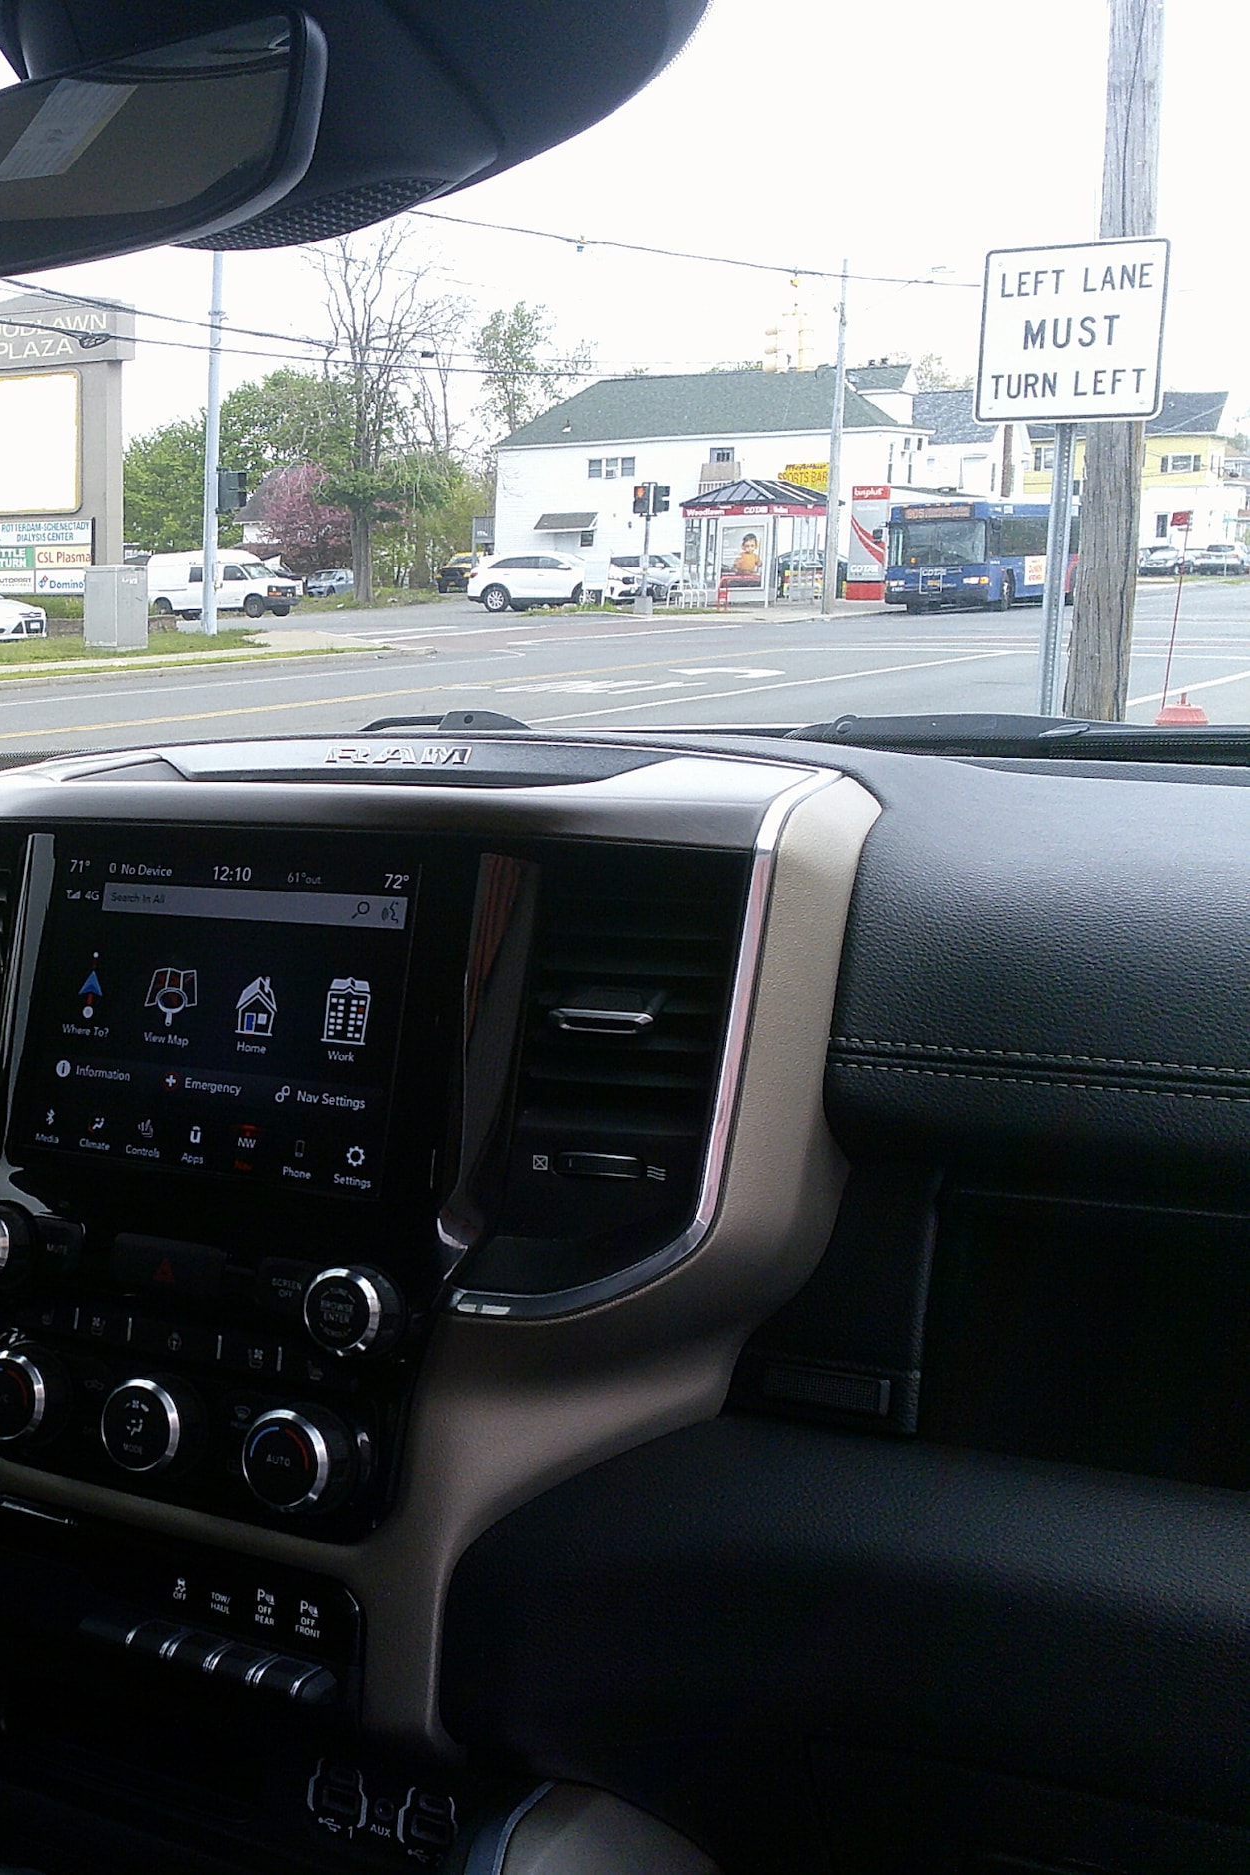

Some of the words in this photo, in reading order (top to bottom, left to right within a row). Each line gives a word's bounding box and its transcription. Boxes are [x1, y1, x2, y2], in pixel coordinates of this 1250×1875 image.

[1001, 269, 1065, 298] LEFT
[1083, 263, 1154, 293] LANE
[1023, 314, 1120, 350] MUST
[991, 372, 1057, 400] TURN
[1073, 368, 1146, 396] LEFT
[1, 522, 90, 533] ROTTERDAM-SCHENECTADY
[17, 533, 46, 542] DIALYSIS
[47, 532, 74, 541] CENTER
[37, 552, 54, 563] CSL
[56, 551, 91, 563] Plasma
[324, 745, 473, 765] RAM
[69, 859, 91, 873] 71°
[121, 863, 136, 875] No
[138, 863, 173, 877] Device
[212, 866, 252, 882] 12:10
[384, 873, 410, 889] 72°
[84, 890, 100, 900] 4G
[110, 892, 140, 903] Search
[62, 1023, 91, 1036] Where
[93, 1026, 110, 1038] To?
[144, 1031, 165, 1044] View
[167, 1034, 189, 1048] Map
[236, 1041, 267, 1055] Home
[328, 1050, 355, 1063] Work
[76, 1065, 131, 1082] Information
[184, 1077, 242, 1097] Emergency
[297, 1090, 319, 1103] Nav
[321, 1093, 366, 1111] Settings
[35, 1133, 60, 1144] Media
[79, 1138, 111, 1151] Climate
[237, 1137, 257, 1149] NW
[125, 1145, 160, 1159] Controls
[181, 1152, 204, 1165] Apps
[282, 1166, 312, 1179] Phone
[333, 1174, 372, 1189] Settings
[266, 1453, 291, 1467] AUTO
[172, 1591, 187, 1601] OFF
[257, 1605, 272, 1616] OFF
[255, 1614, 275, 1626] REAR
[300, 1617, 316, 1628] OFF
[295, 1625, 321, 1639] FRONT
[370, 1823, 391, 1838] AUX
